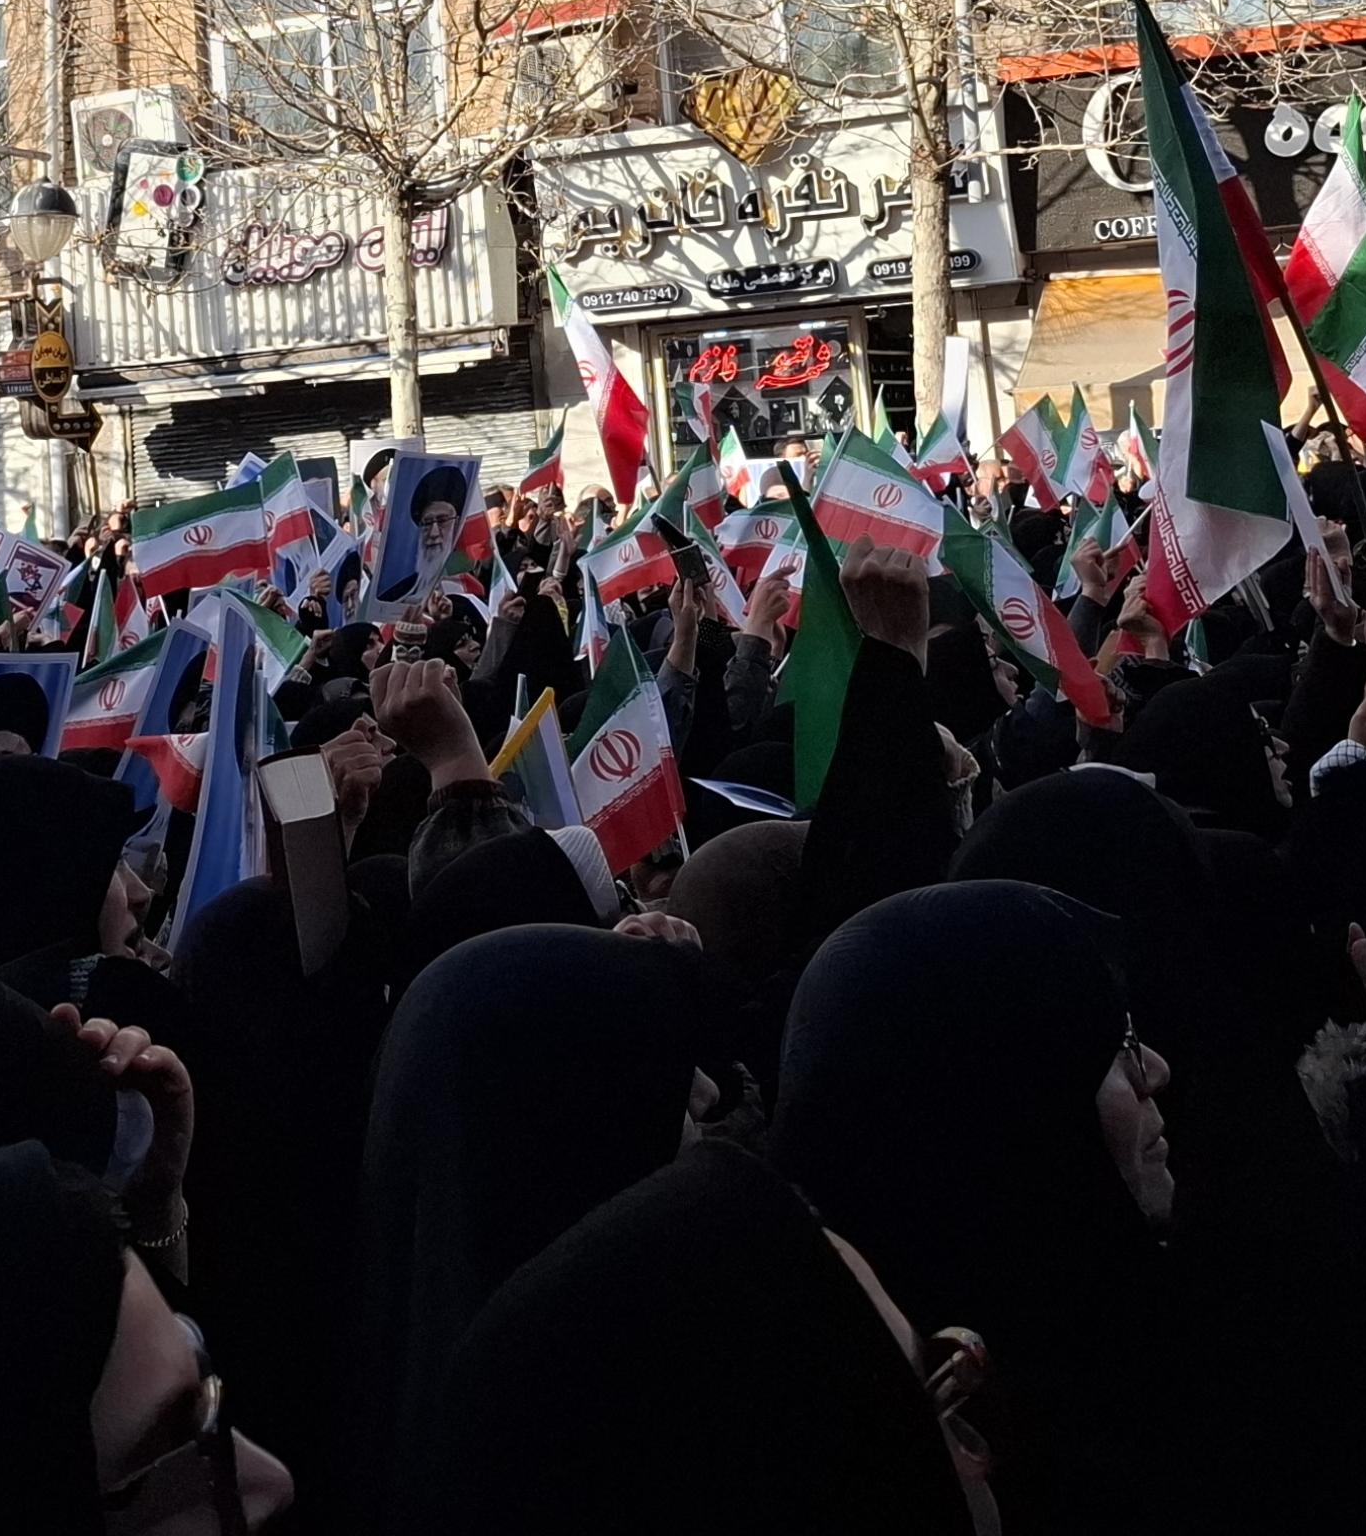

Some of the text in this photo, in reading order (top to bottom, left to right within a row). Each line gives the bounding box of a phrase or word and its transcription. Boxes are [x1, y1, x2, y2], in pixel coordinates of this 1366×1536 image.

[737, 153, 849, 247] نقره
[743, 264, 795, 291] تخصصی
[800, 264, 831, 285] مرکز
[872, 260, 906, 276] 0919
[582, 293, 614, 307] 0912
[615, 290, 639, 304] 740
